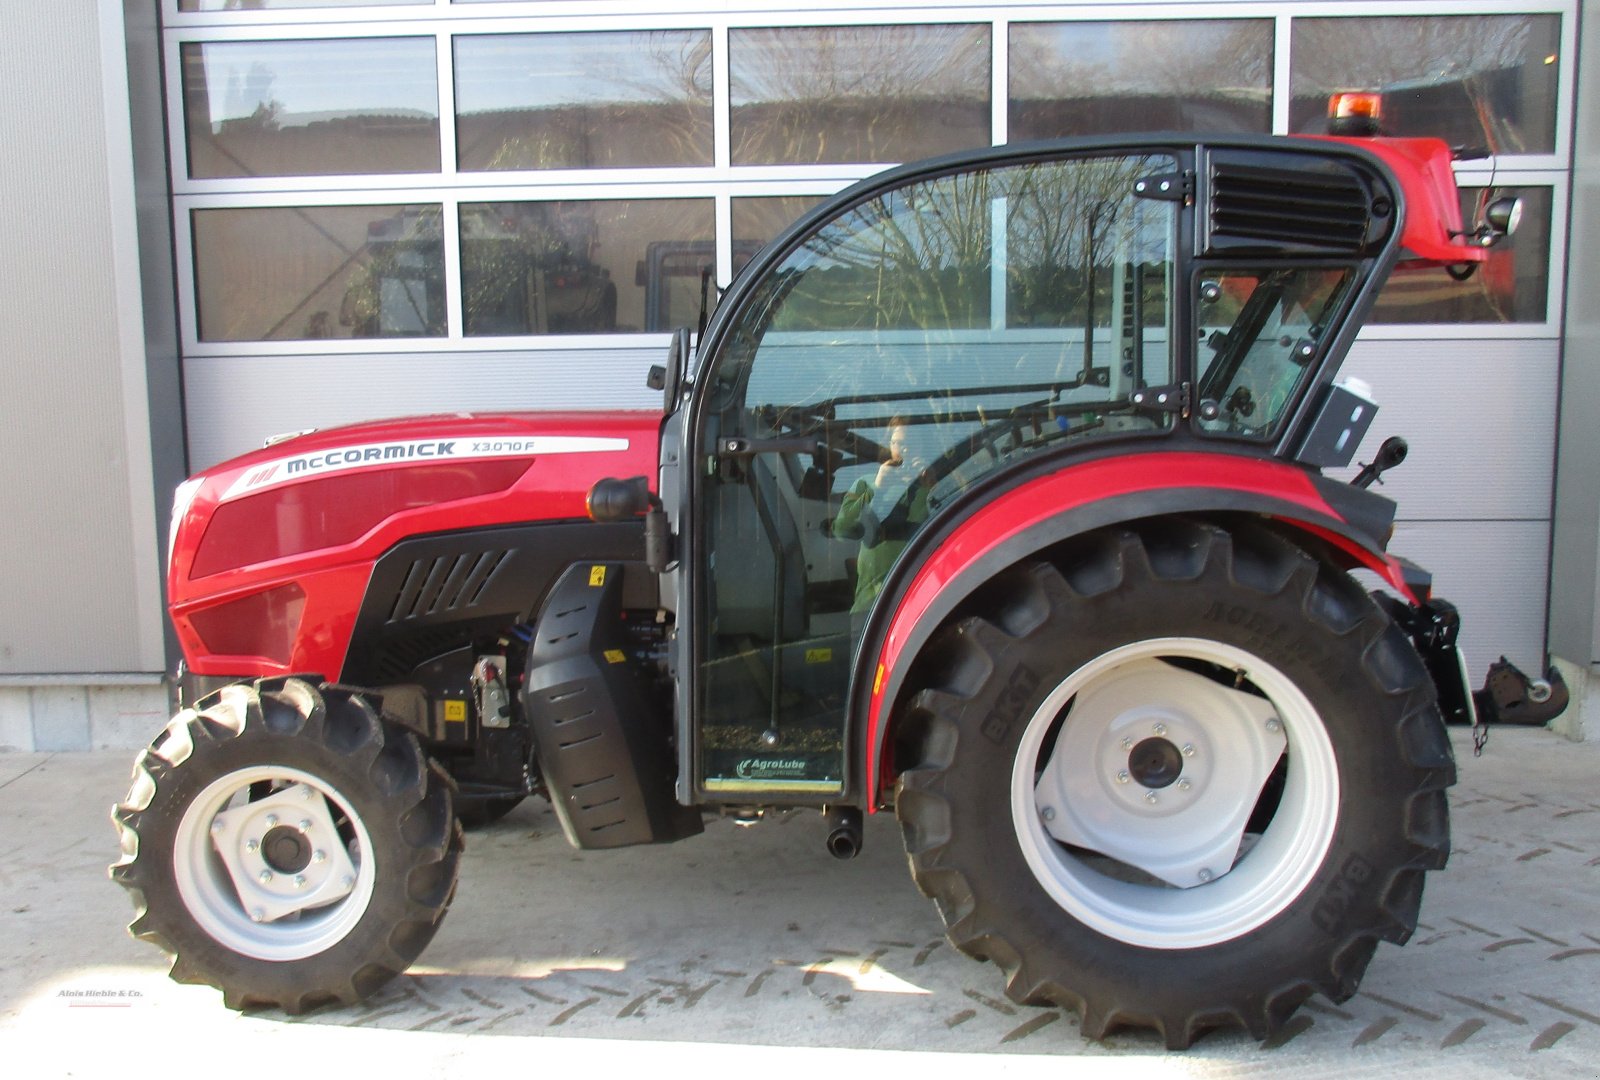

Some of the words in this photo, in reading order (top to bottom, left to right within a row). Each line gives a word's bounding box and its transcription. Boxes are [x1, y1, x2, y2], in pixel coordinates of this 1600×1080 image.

[472, 441, 522, 452] X3.070
[525, 441, 535, 451] F
[751, 759, 805, 770] AgroLube
